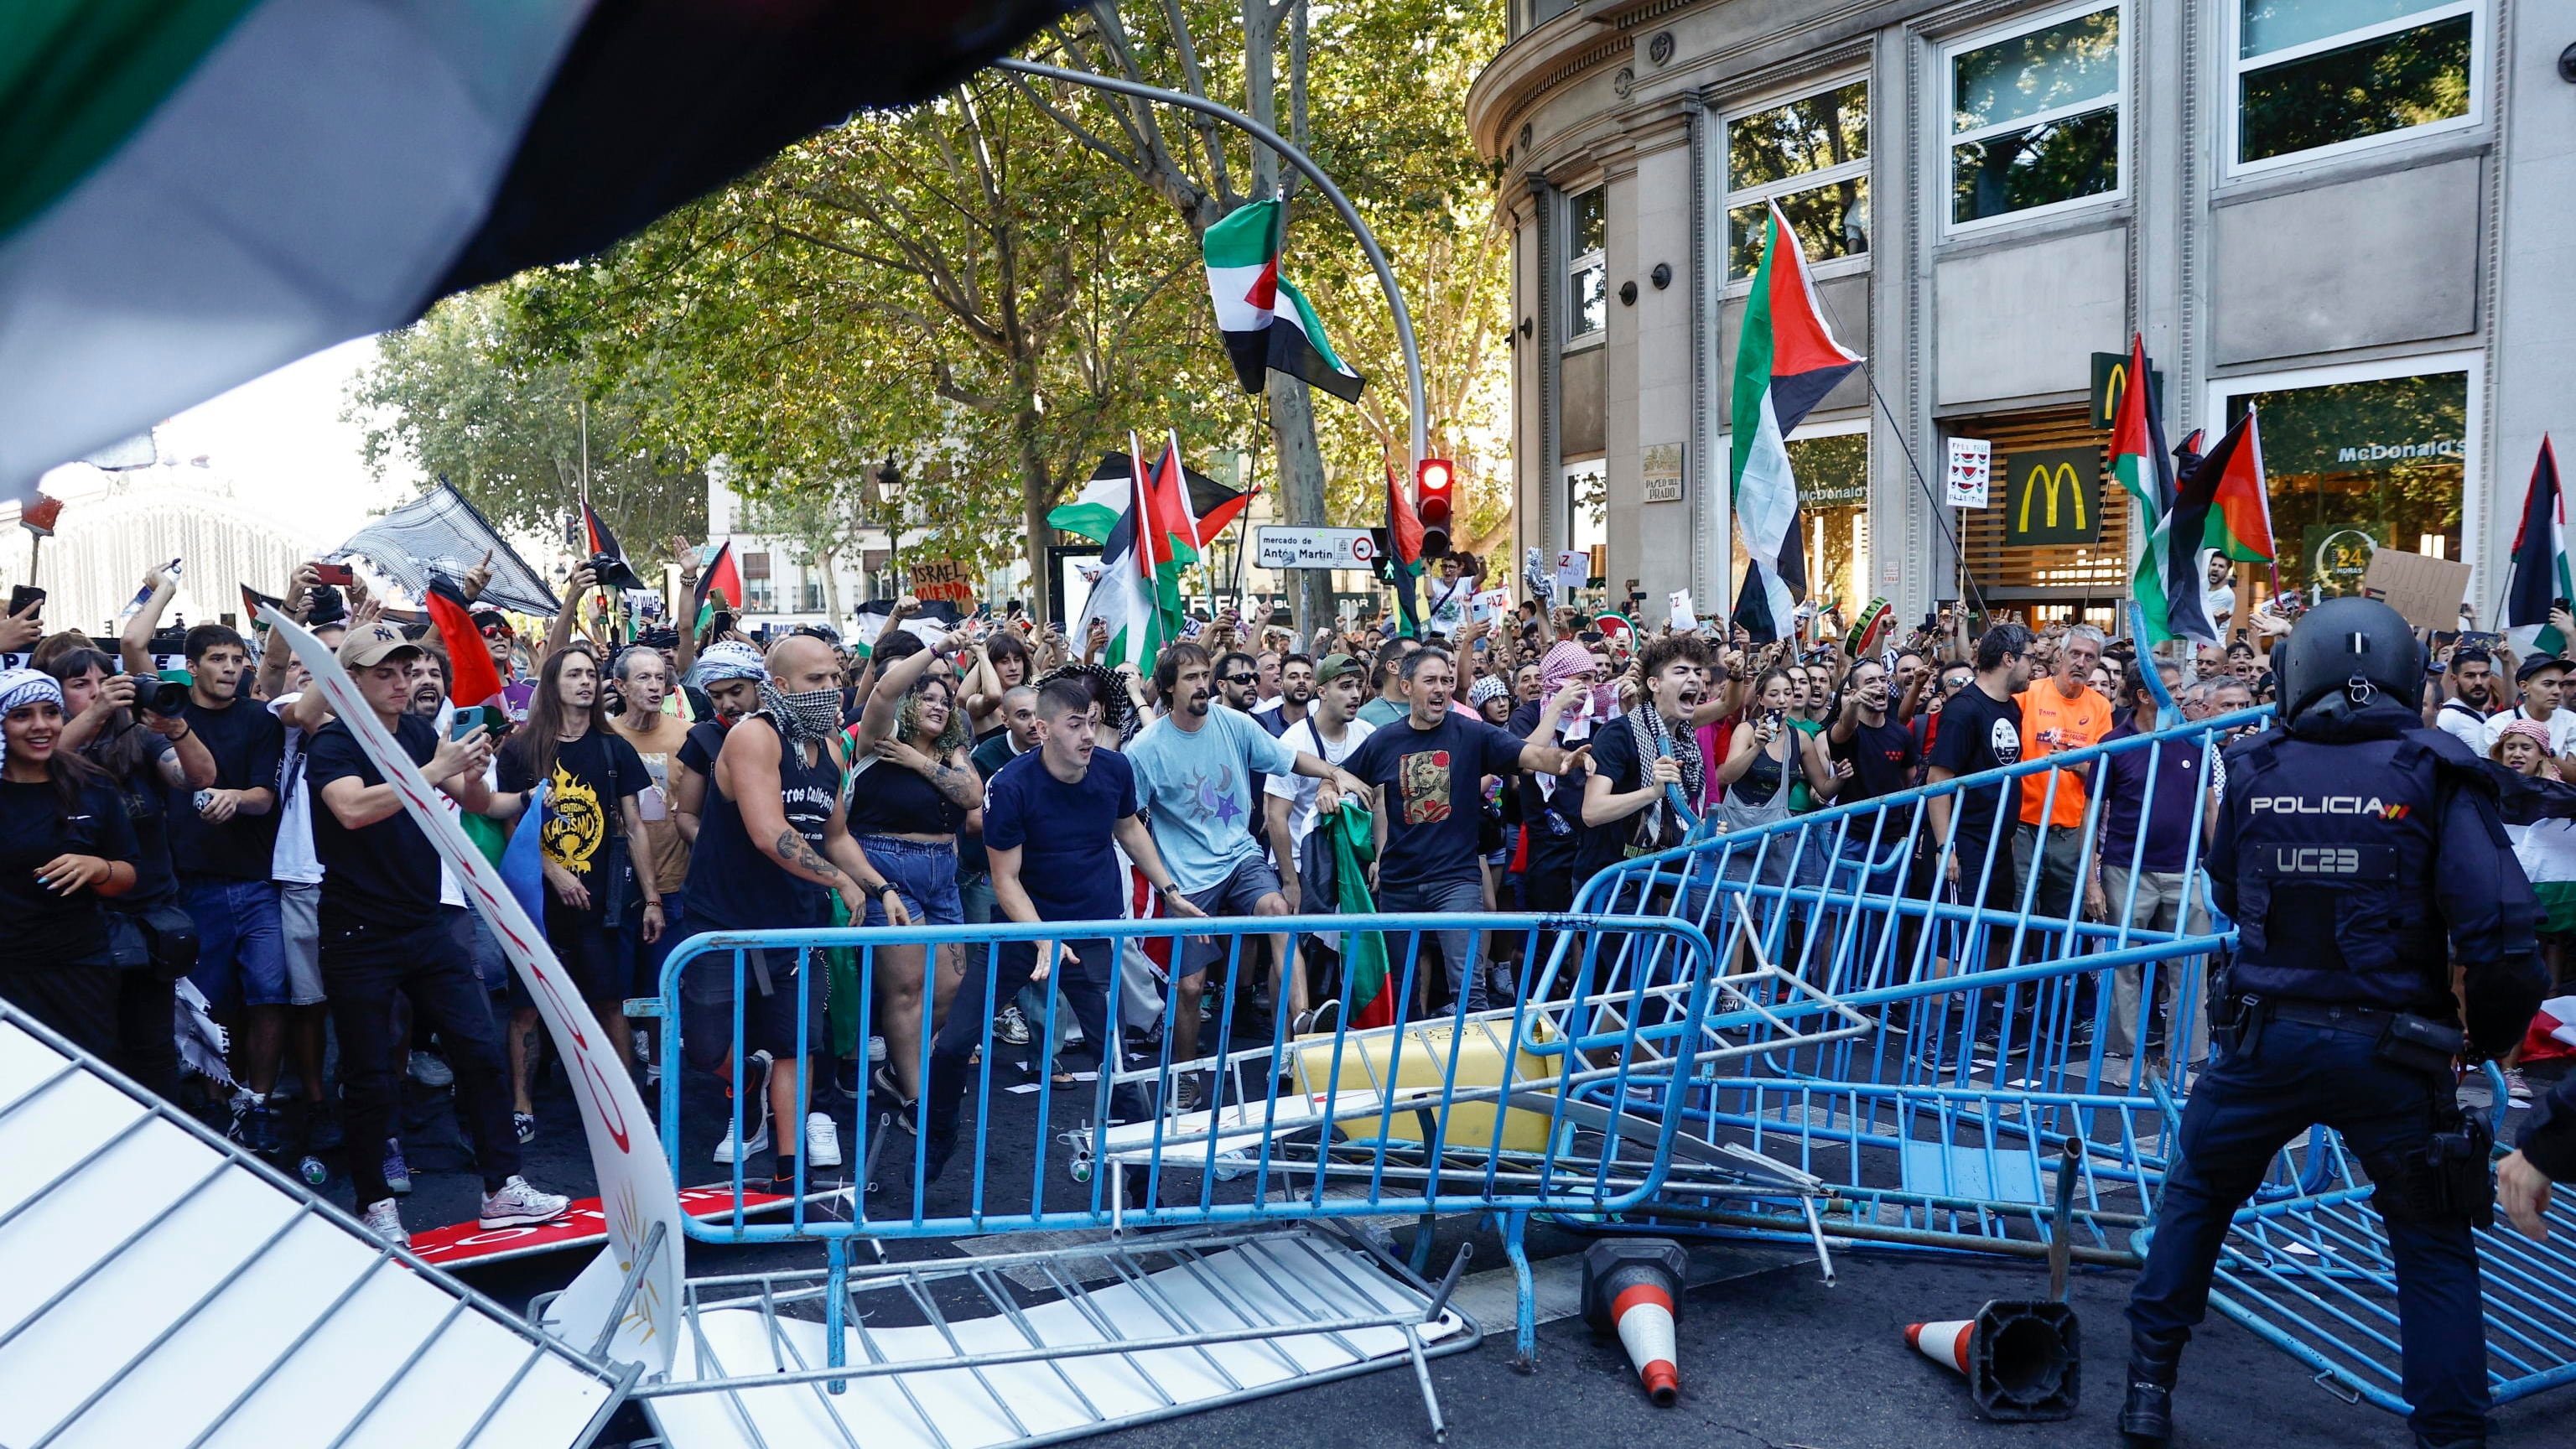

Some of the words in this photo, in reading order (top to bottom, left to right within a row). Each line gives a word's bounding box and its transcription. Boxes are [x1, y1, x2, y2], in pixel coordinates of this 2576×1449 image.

[2338, 440, 2466, 462] McDonald's
[1646, 479, 1667, 489] PASEO
[1649, 487, 1675, 499] PRADO
[2337, 548, 2364, 567] 24
[914, 581, 974, 600] MIERDA
[640, 595, 660, 610] WAR
[1487, 595, 1503, 609] PAZ
[2251, 797, 2386, 814] POLICIA
[2277, 849, 2359, 873] UC23
